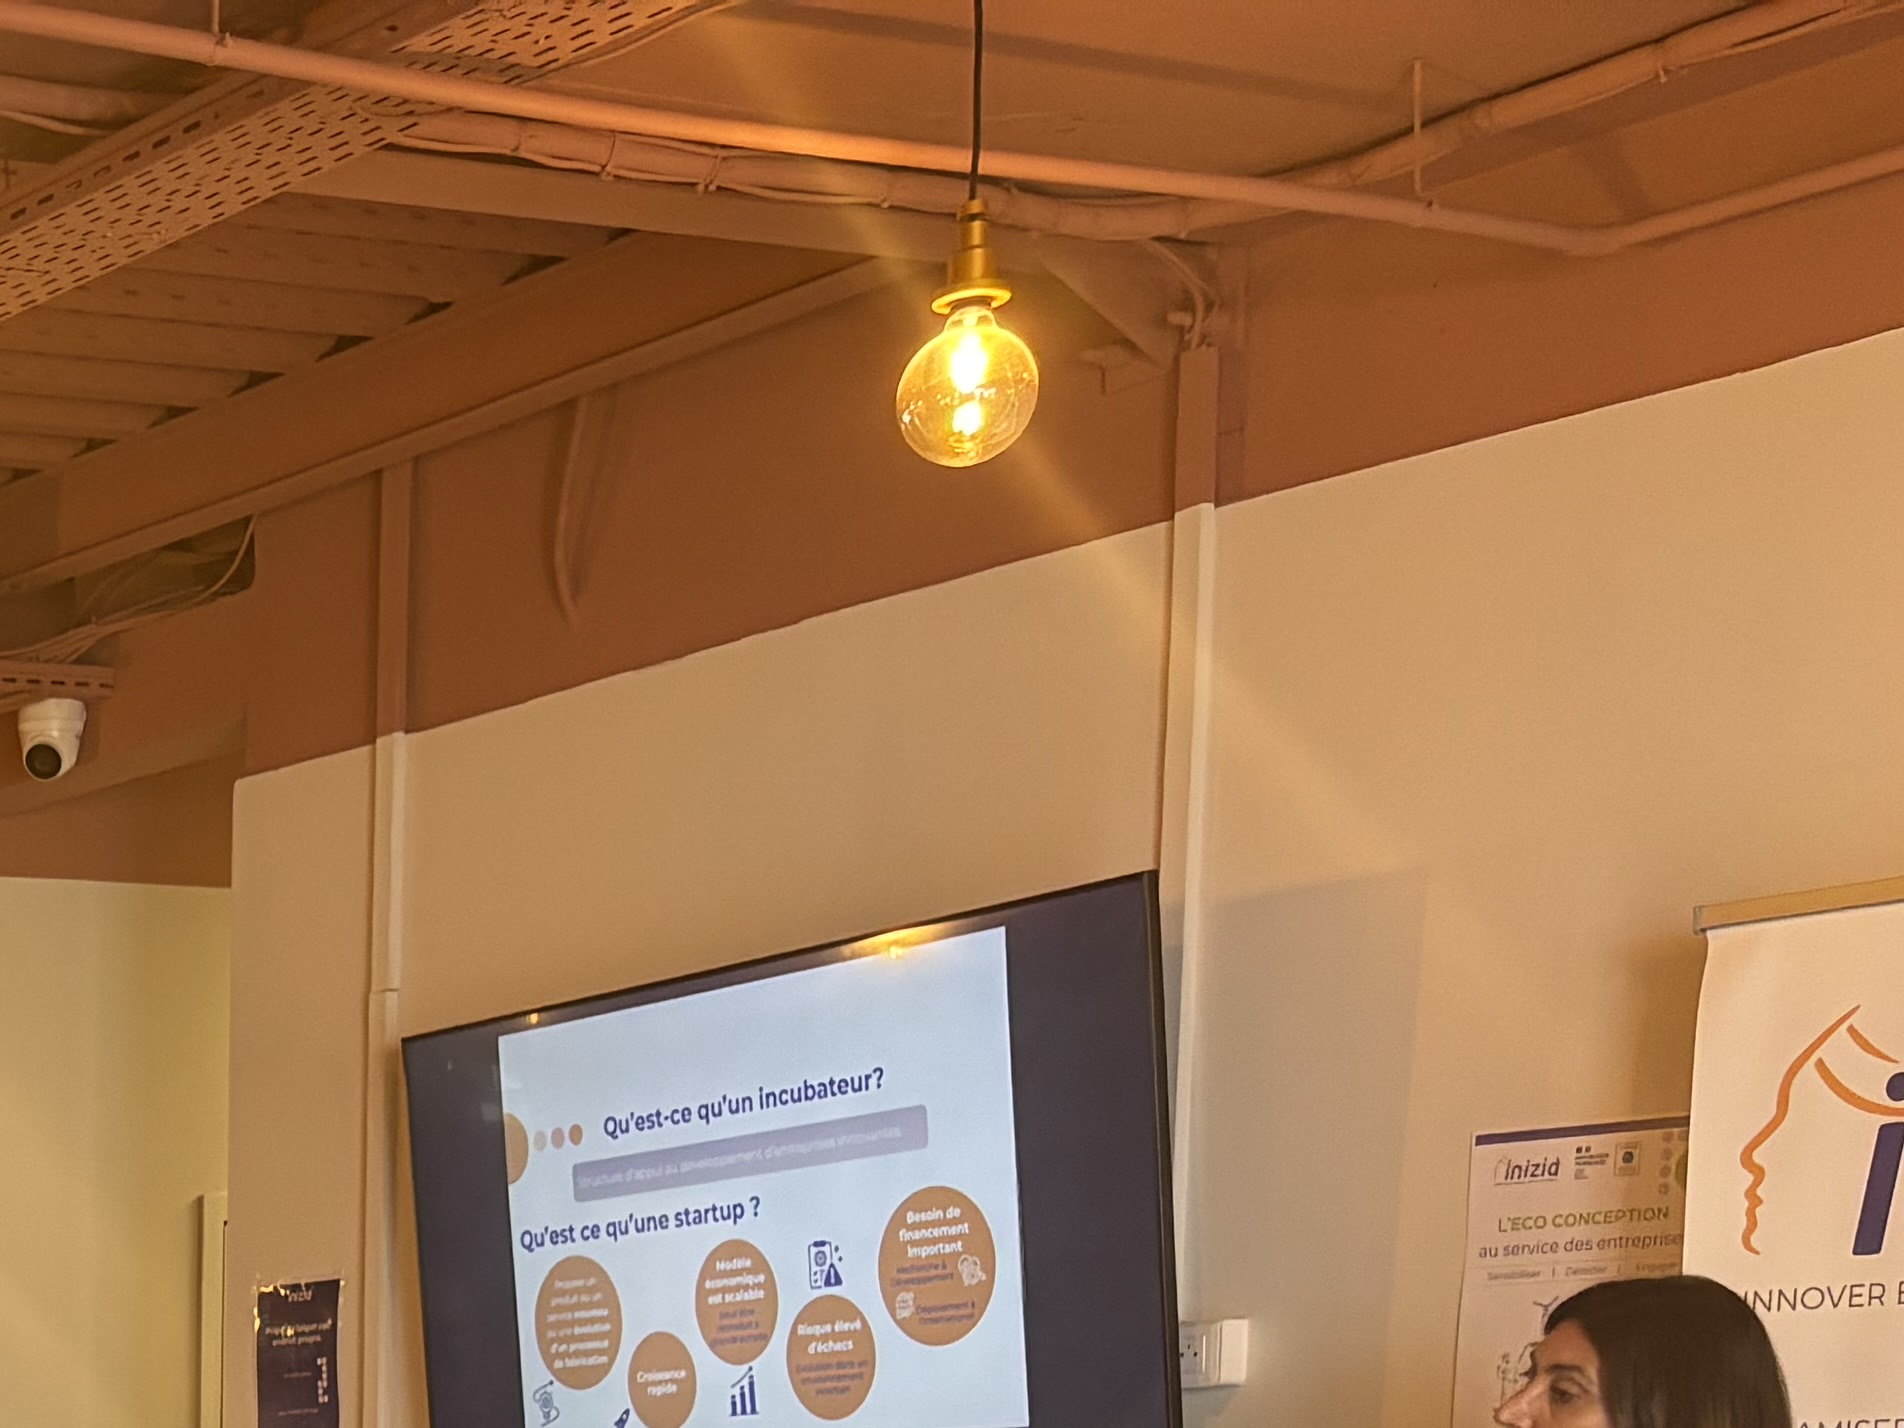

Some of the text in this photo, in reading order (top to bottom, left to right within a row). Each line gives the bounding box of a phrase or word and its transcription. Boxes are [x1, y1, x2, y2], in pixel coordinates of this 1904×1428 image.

[603, 1067, 884, 1140] Qu'est-ce qu'un incubateur?
[520, 1196, 761, 1253] Qu'est ce qu'une startup ?
[1498, 1206, 1669, 1233] L'ECO CONCEPTION
[1478, 1246, 1498, 1258] au
[1503, 1240, 1559, 1257] service
[1563, 1237, 1593, 1252] des
